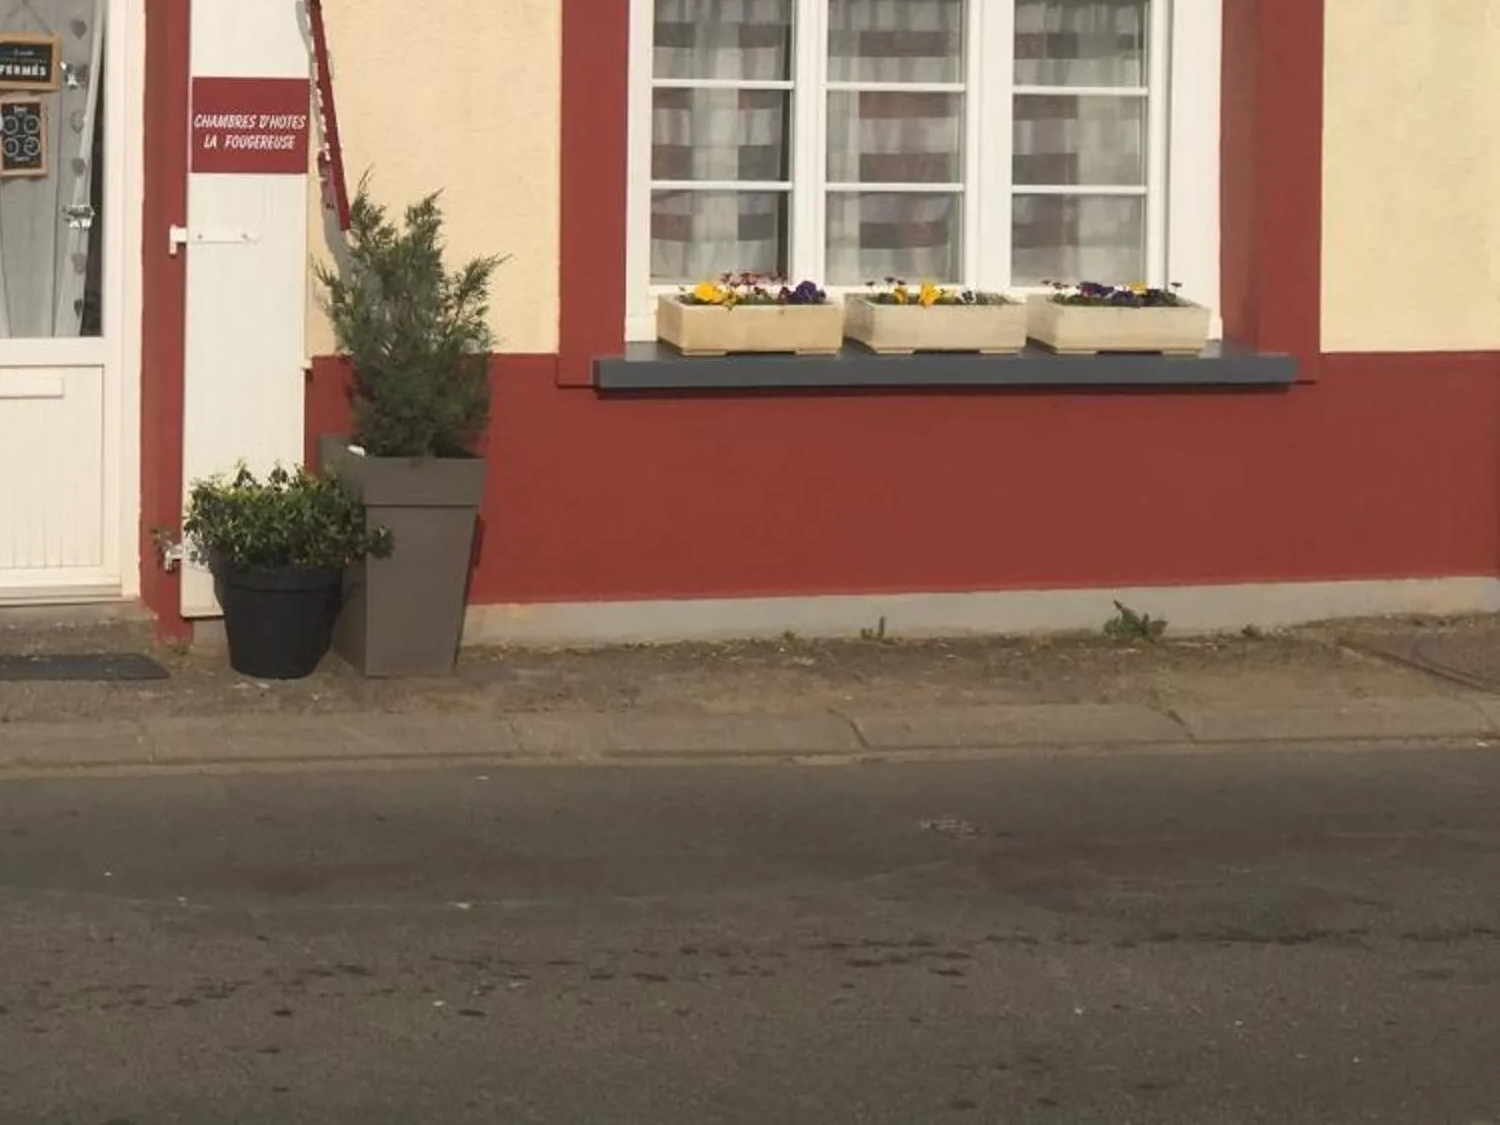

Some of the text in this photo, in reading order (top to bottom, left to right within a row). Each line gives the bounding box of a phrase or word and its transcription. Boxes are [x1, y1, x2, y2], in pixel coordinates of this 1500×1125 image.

[194, 114, 257, 129] CHAMBRES
[204, 134, 296, 150] LA FOUGEREUSE
